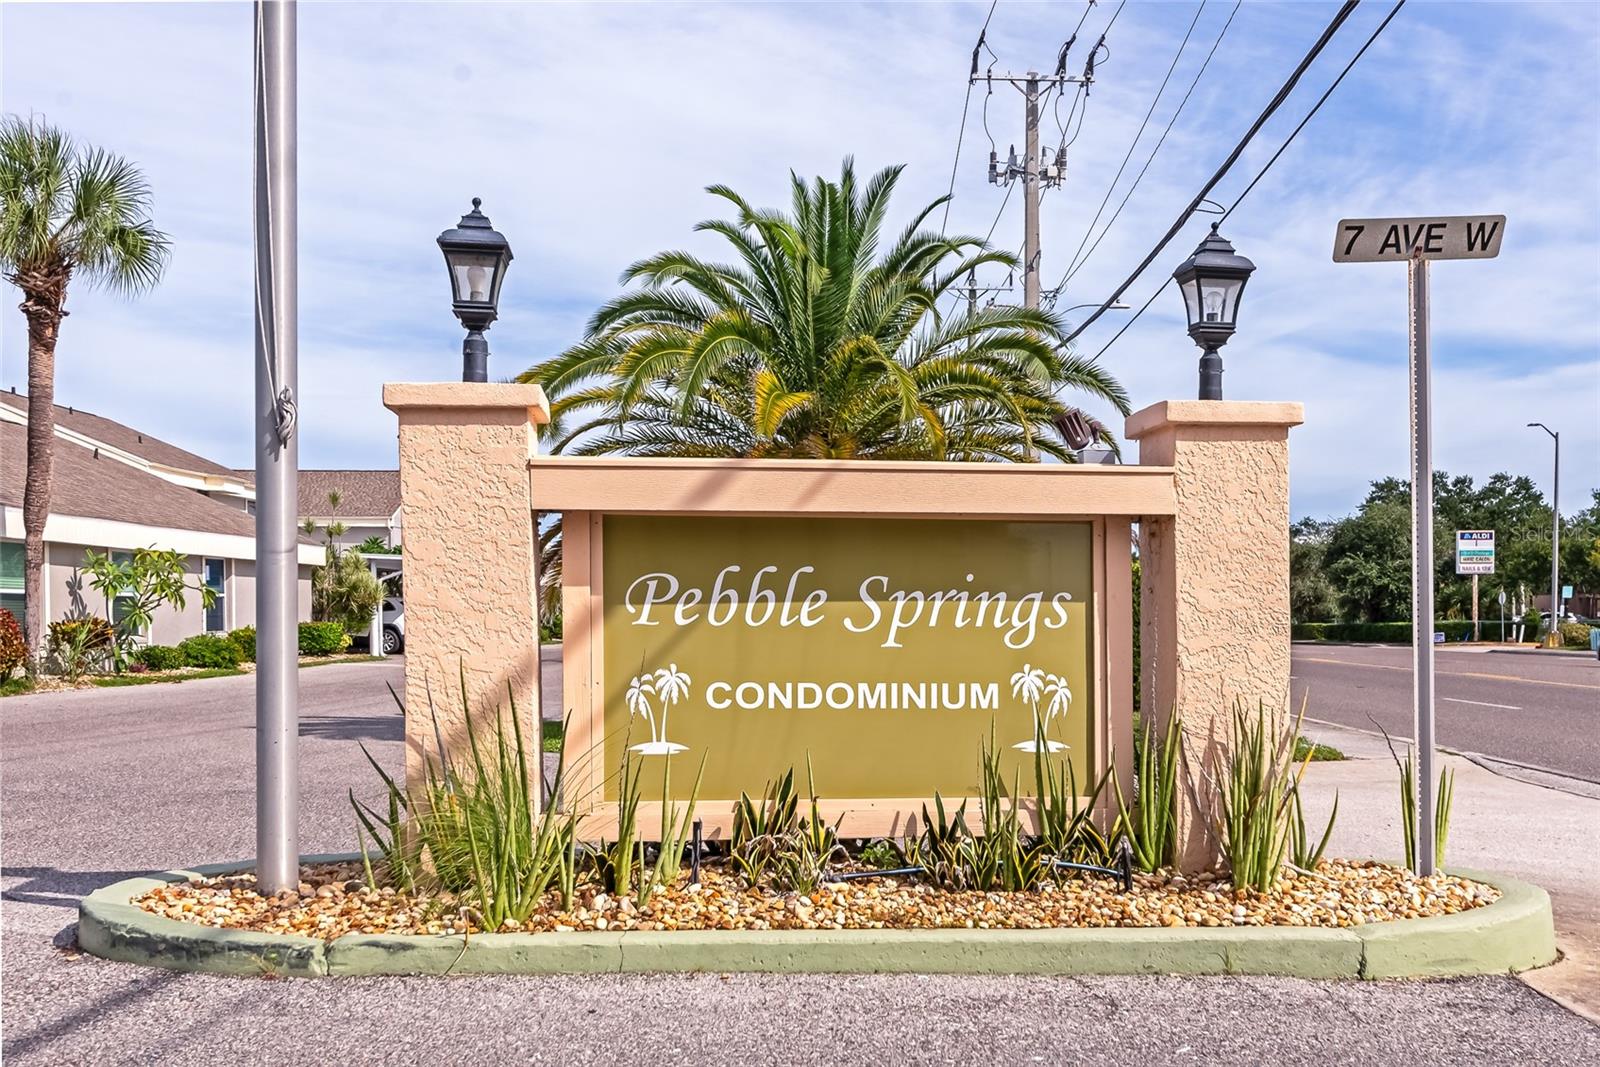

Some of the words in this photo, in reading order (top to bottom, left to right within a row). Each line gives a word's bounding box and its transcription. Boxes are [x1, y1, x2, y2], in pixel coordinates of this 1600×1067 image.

[1344, 225, 1365, 255] 7
[1378, 223, 1447, 255] AVE
[1466, 221, 1499, 252] W
[624, 565, 828, 627] Pebble
[842, 573, 1073, 650] Springs
[705, 681, 1000, 710] CONDOMINIUM
